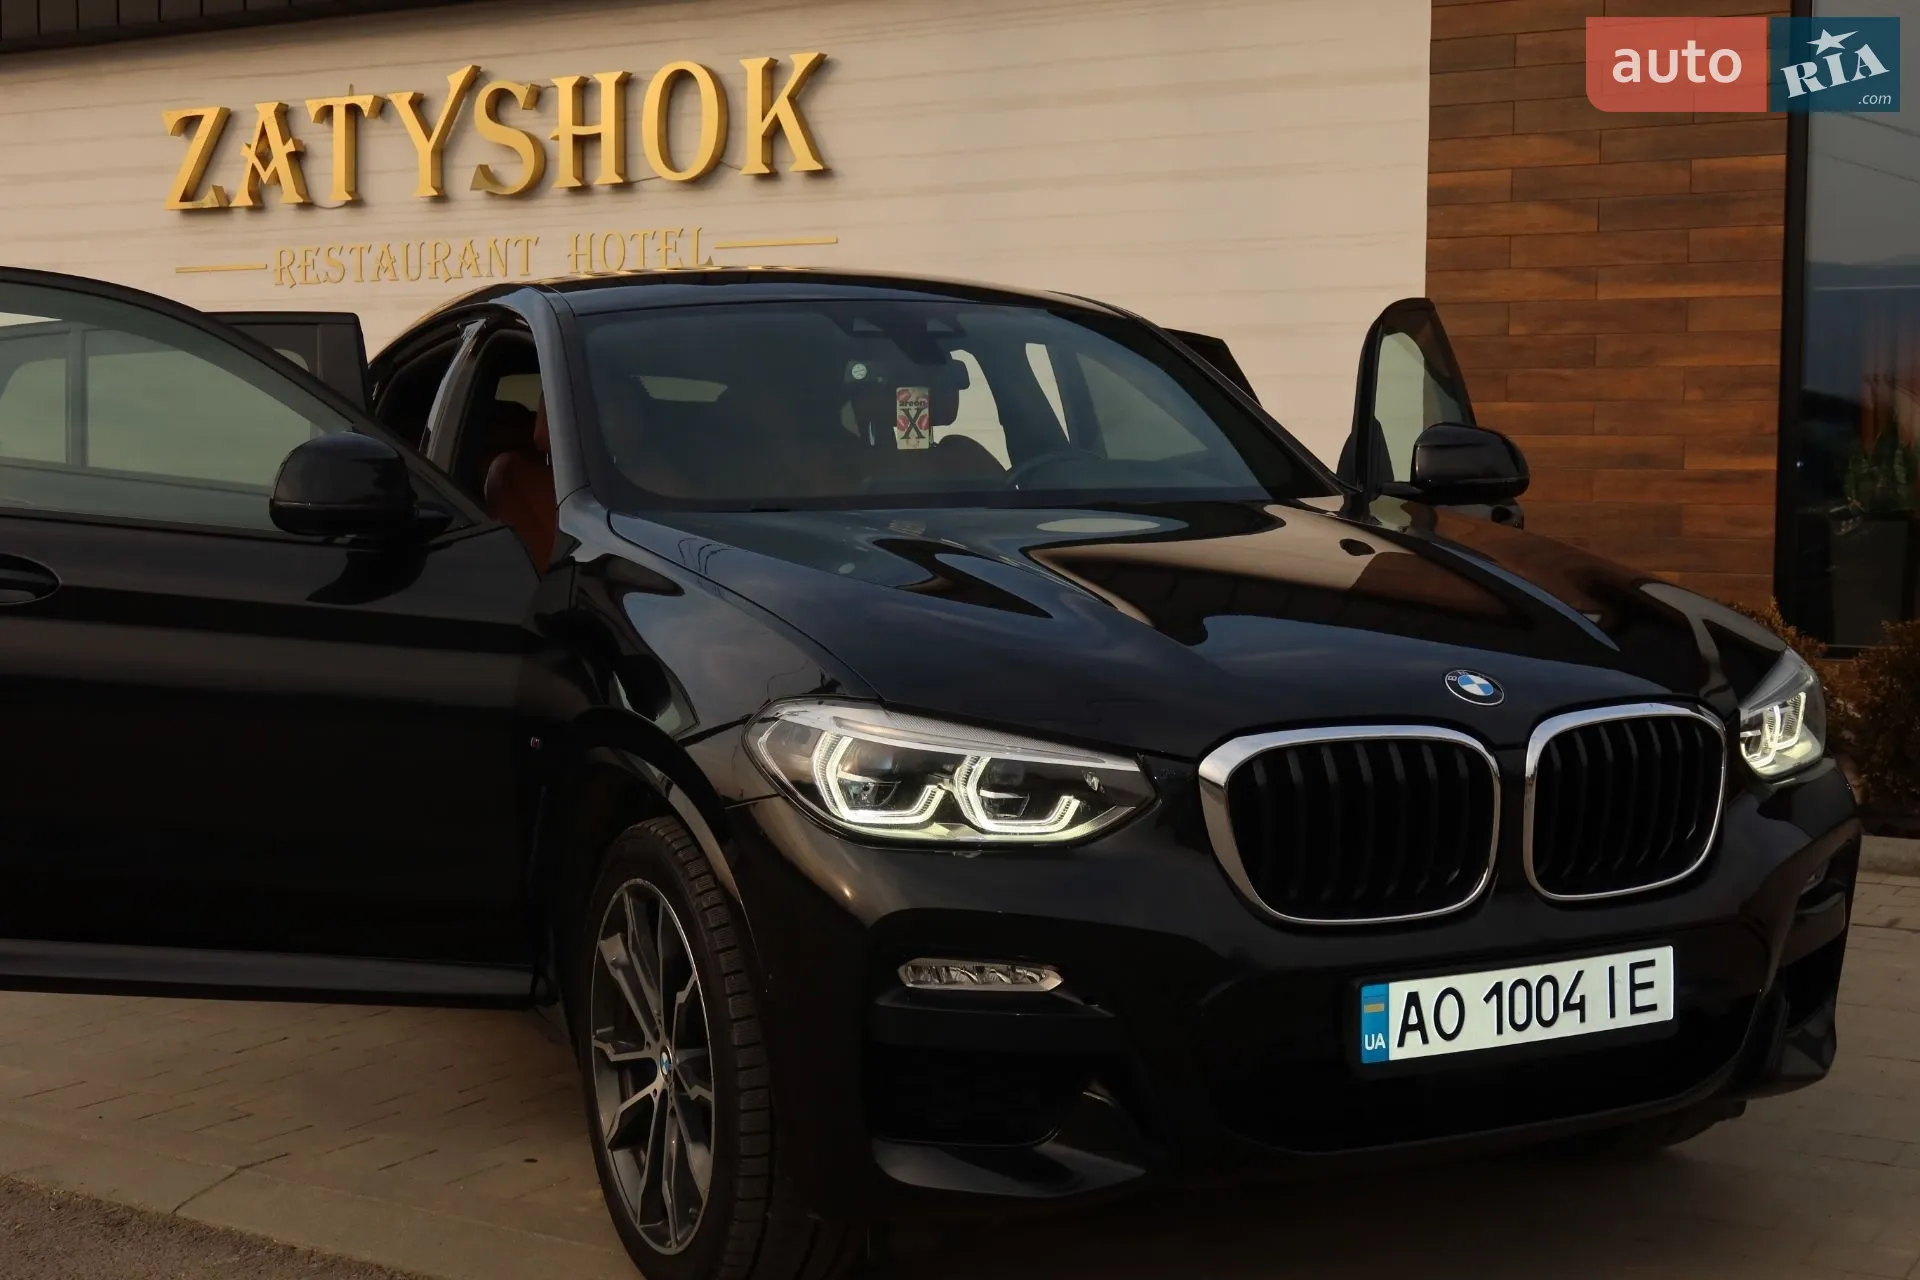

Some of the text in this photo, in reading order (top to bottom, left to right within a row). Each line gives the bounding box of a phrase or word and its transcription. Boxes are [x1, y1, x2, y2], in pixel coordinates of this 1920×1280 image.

[163, 52, 832, 211] ZATYSHOK
[273, 226, 715, 289] RESTAURANT HOTEL
[900, 408, 927, 439] X
[1396, 958, 1659, 1048] AO 1004 IE
[1364, 1033, 1386, 1051] UA
